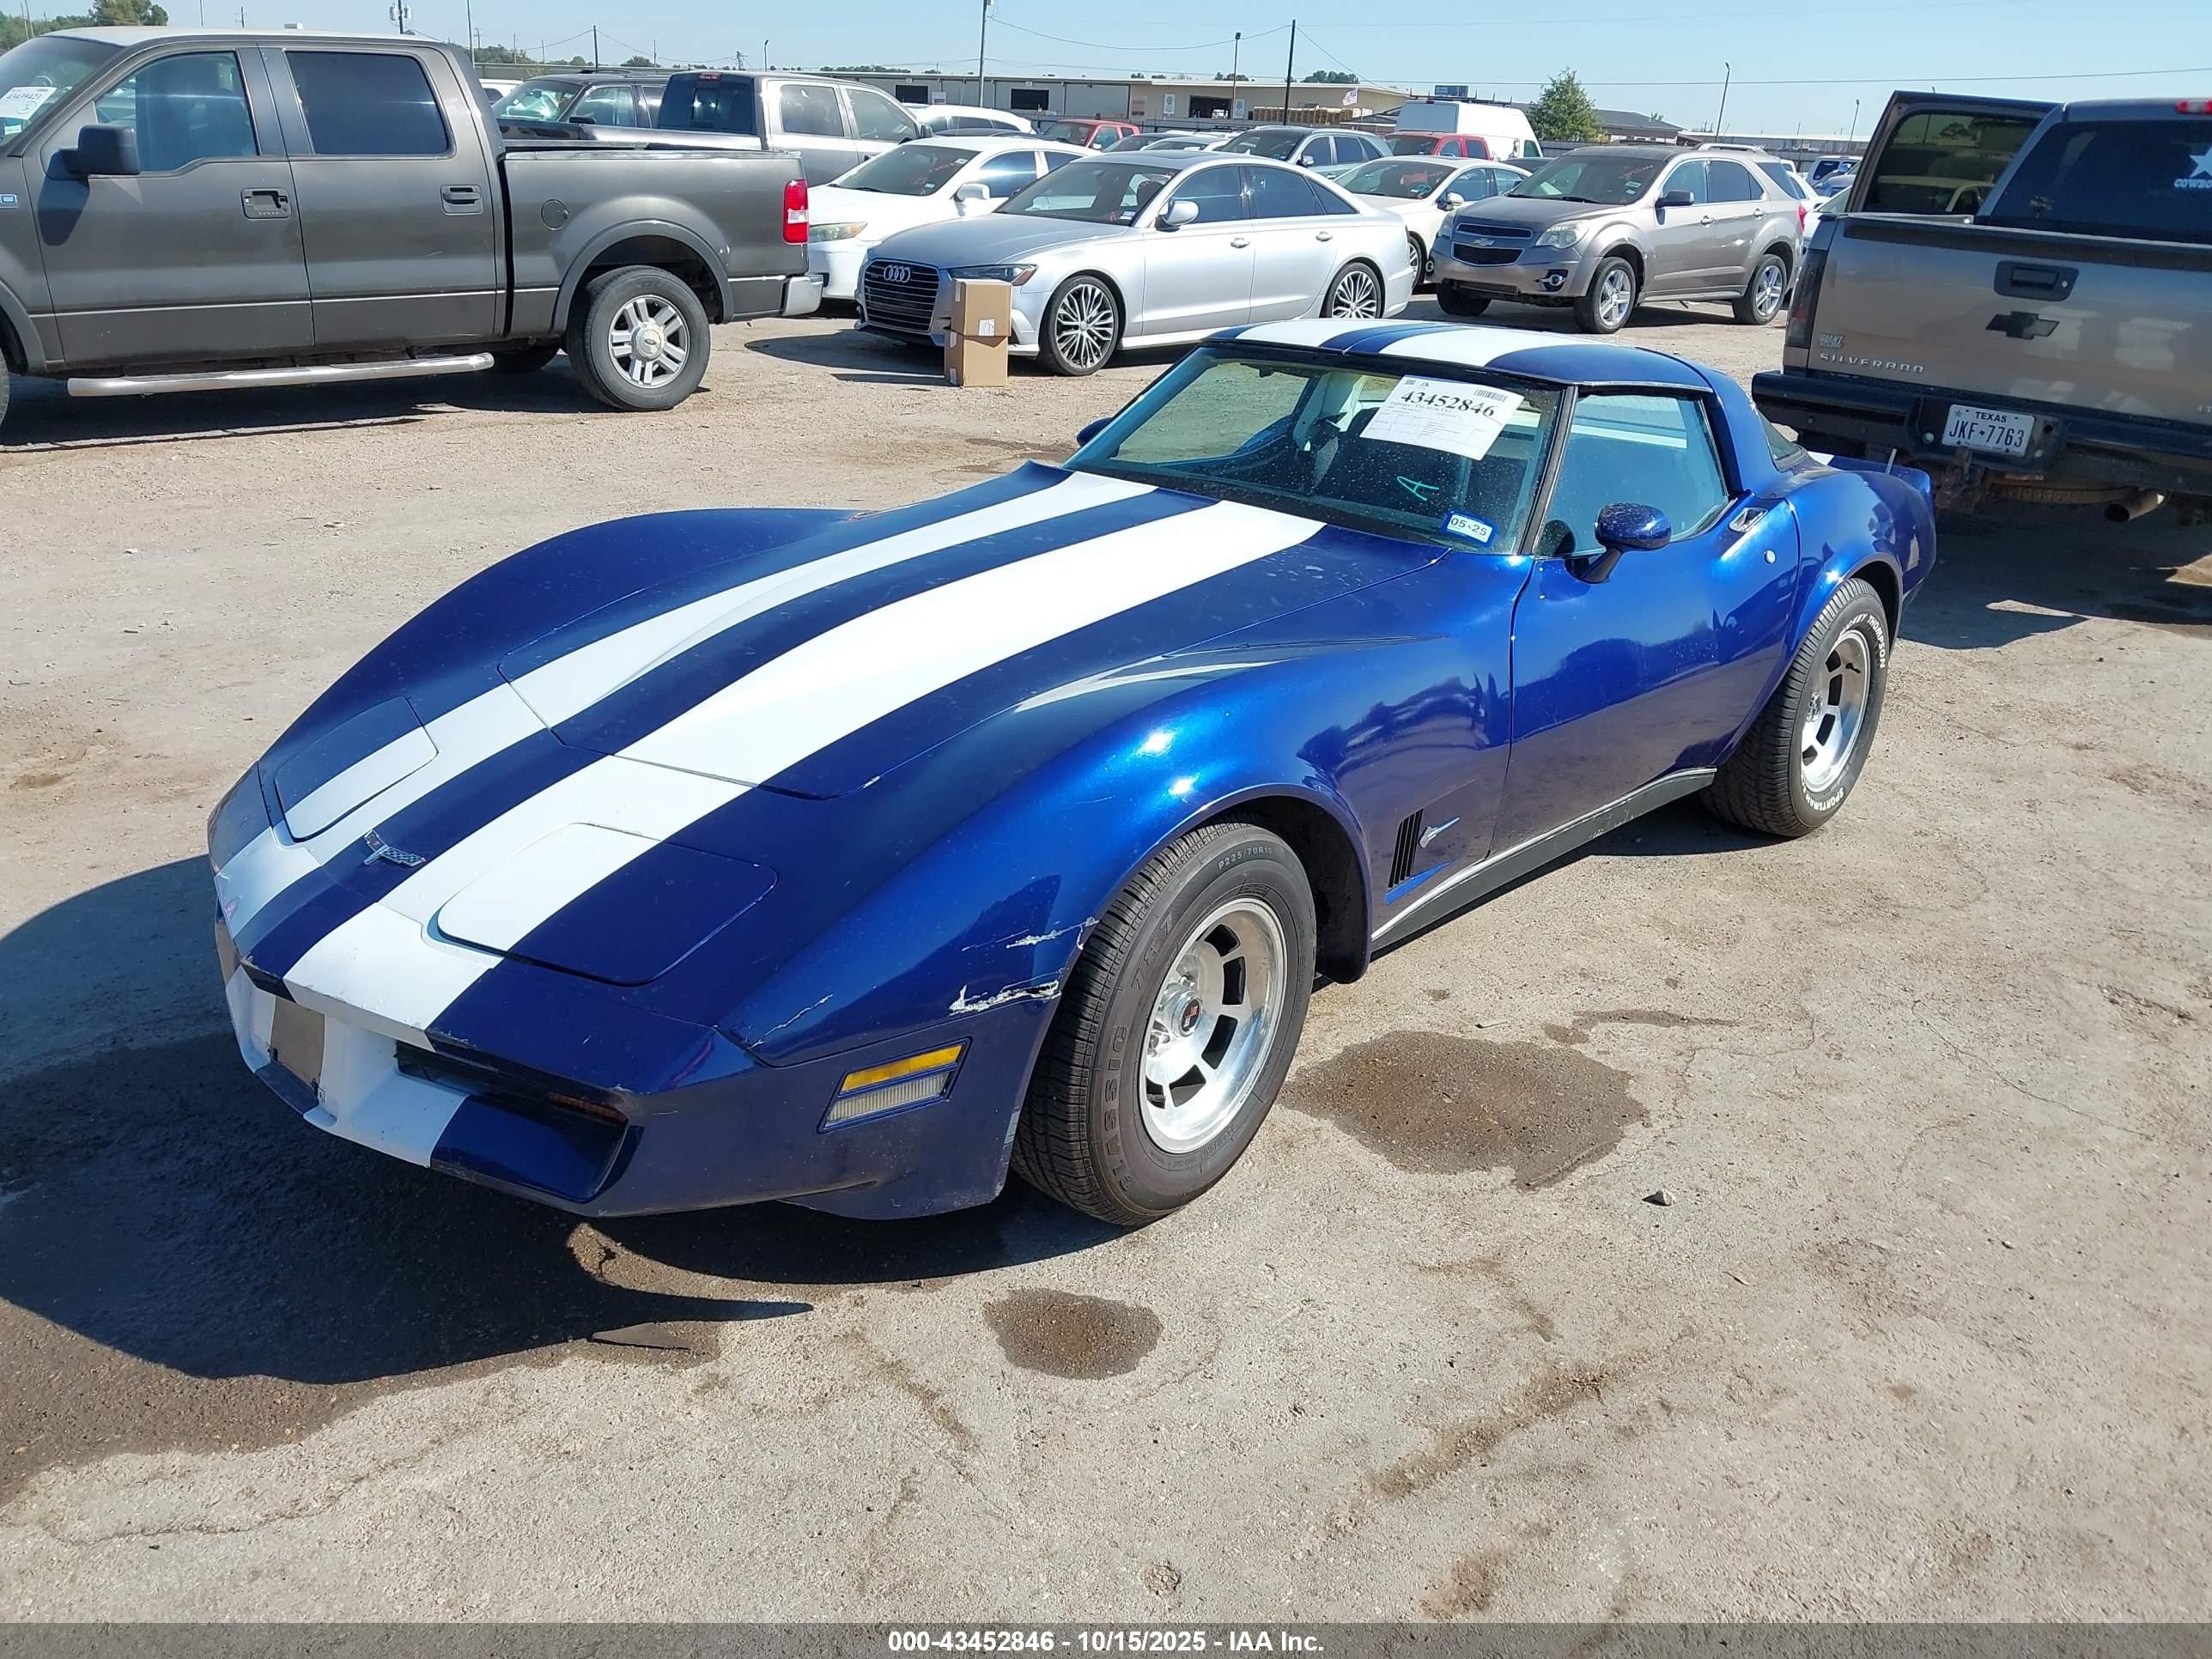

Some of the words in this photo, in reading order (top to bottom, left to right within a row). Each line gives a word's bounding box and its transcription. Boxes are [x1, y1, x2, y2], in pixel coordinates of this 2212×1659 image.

[1820, 353, 1923, 373] SILVERADO
[1401, 391, 1498, 418] 43452846
[1976, 411, 2007, 422] TEXAS
[1949, 420, 1978, 440] JKF
[1986, 424, 2025, 447] 7763
[1396, 476, 1440, 501] A
[1867, 614, 1886, 669] THOMPSON
[1218, 846, 1273, 871] P225/70R15
[1104, 1025, 1133, 1192] CLASSIC
